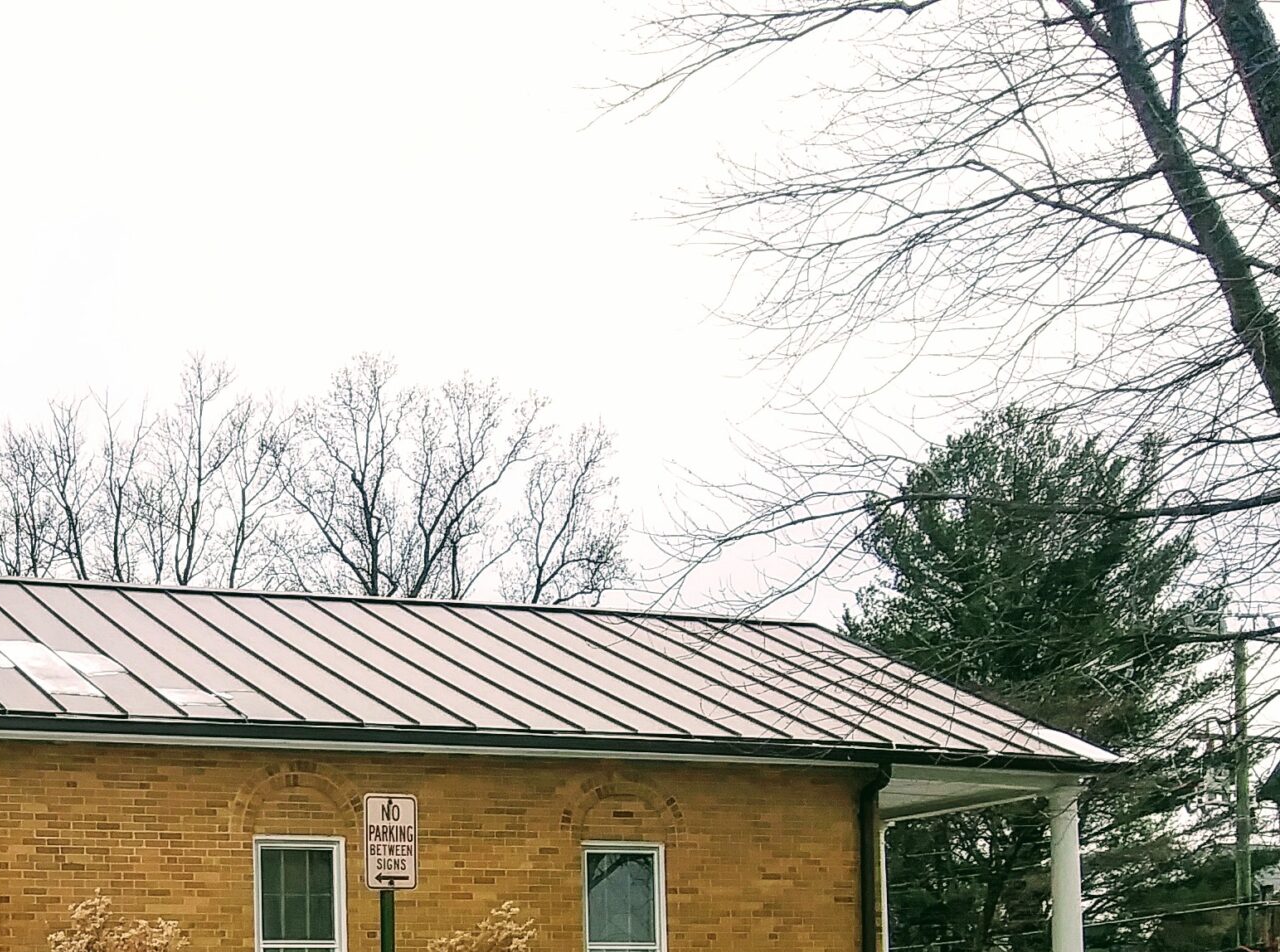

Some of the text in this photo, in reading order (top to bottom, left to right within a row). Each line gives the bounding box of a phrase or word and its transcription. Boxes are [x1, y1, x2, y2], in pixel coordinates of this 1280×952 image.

[381, 804, 400, 821] NO
[369, 825, 413, 842] PARKING
[370, 844, 413, 856] BETWEEN
[376, 858, 407, 871] SIGNS
